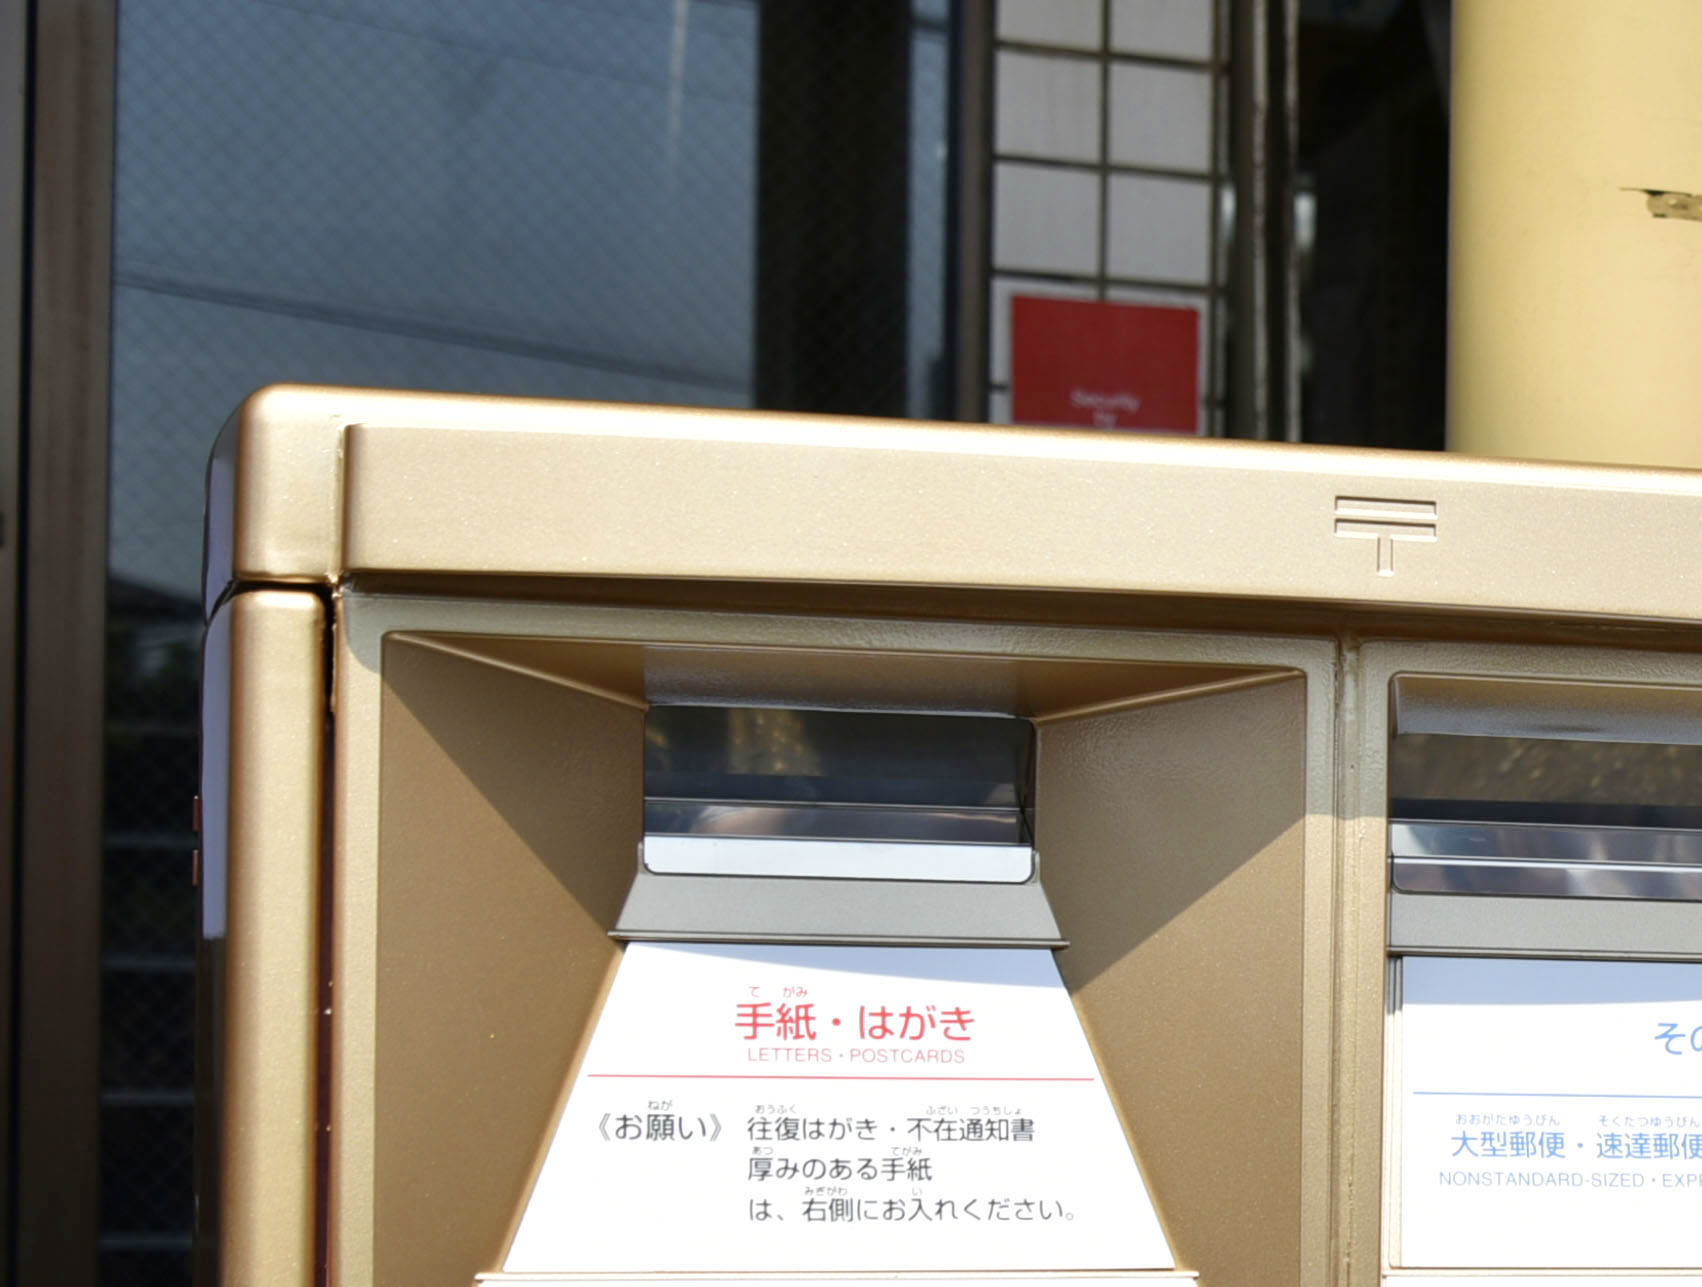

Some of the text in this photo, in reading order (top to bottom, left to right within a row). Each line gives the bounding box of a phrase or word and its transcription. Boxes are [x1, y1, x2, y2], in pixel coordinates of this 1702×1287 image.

[735, 1002, 976, 1042] 手紙・はがき
[747, 1047, 966, 1064] LETTERS POSTCARDS
[598, 1112, 723, 1142] 《お願い》
[747, 1115, 1036, 1142] 往復はがき・不在通知書
[748, 1157, 934, 1182] 厚みのある手紙
[749, 1197, 1075, 1223] は、右側にお入れください。
